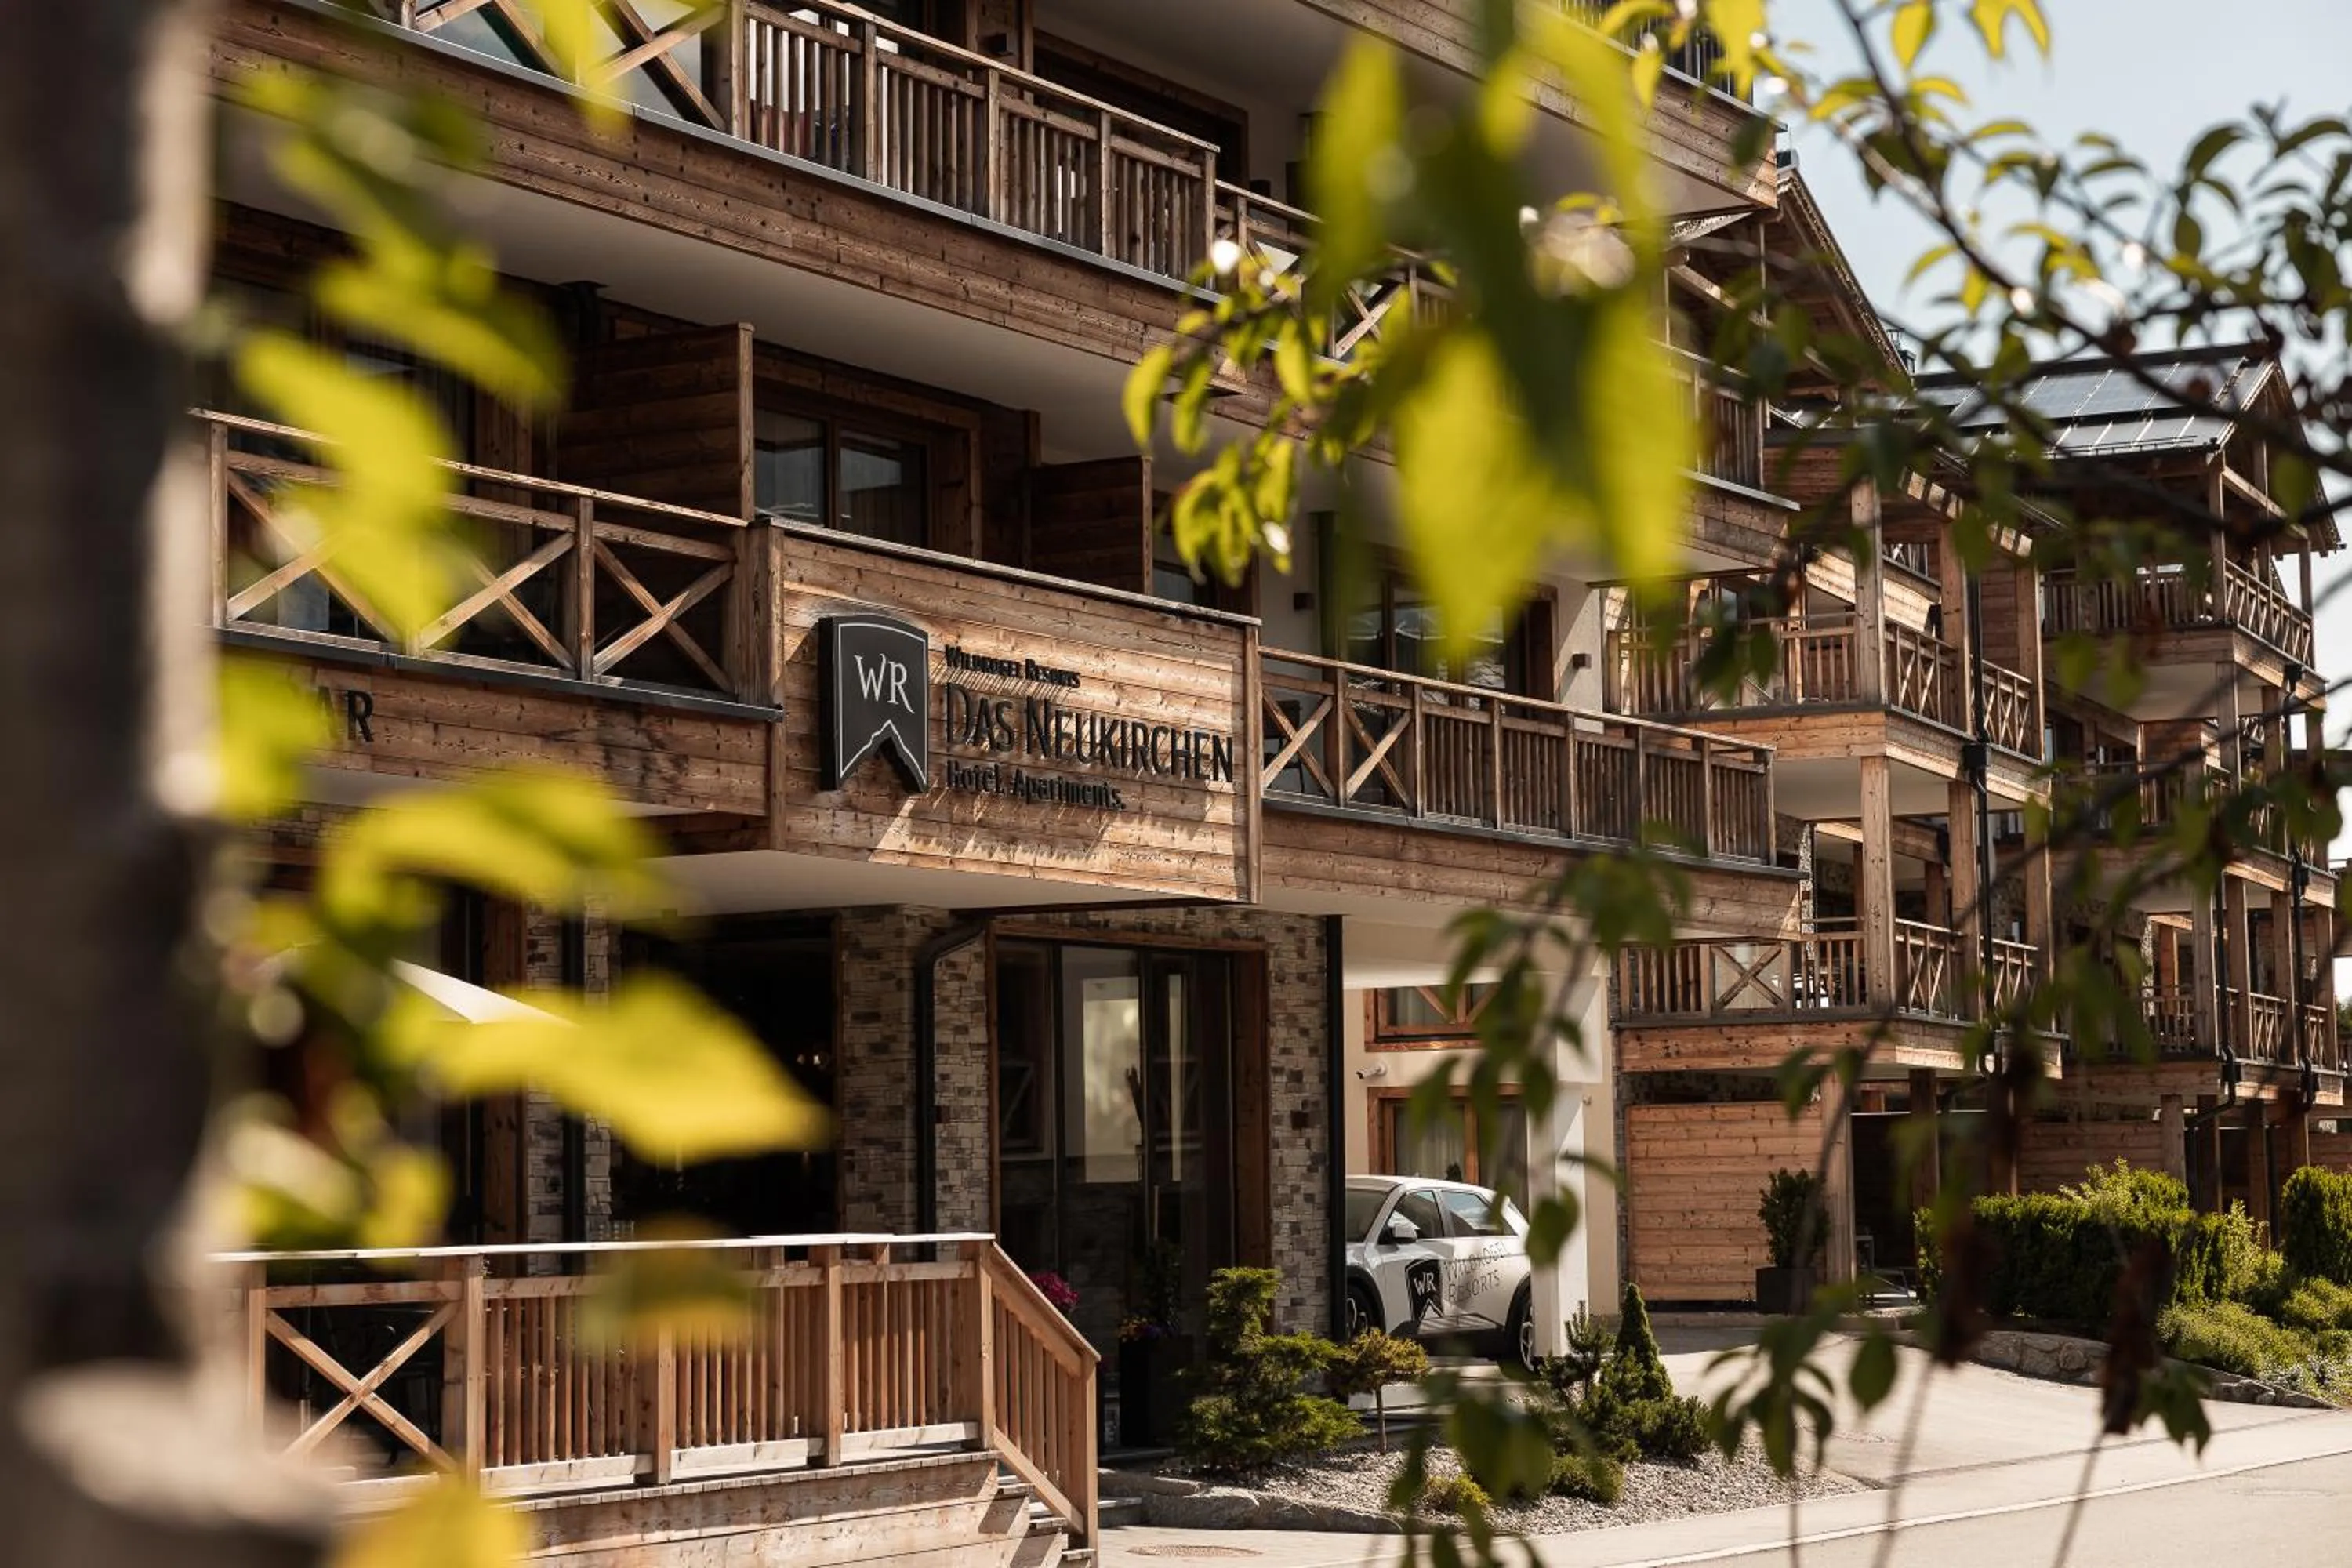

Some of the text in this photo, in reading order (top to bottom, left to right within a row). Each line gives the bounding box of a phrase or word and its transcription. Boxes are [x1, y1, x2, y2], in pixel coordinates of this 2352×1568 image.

[855, 652, 915, 714] WR
[315, 686, 374, 742] AR
[946, 682, 1233, 783] DAS NEUKIRCHEN
[1413, 1272, 1437, 1297] WR
